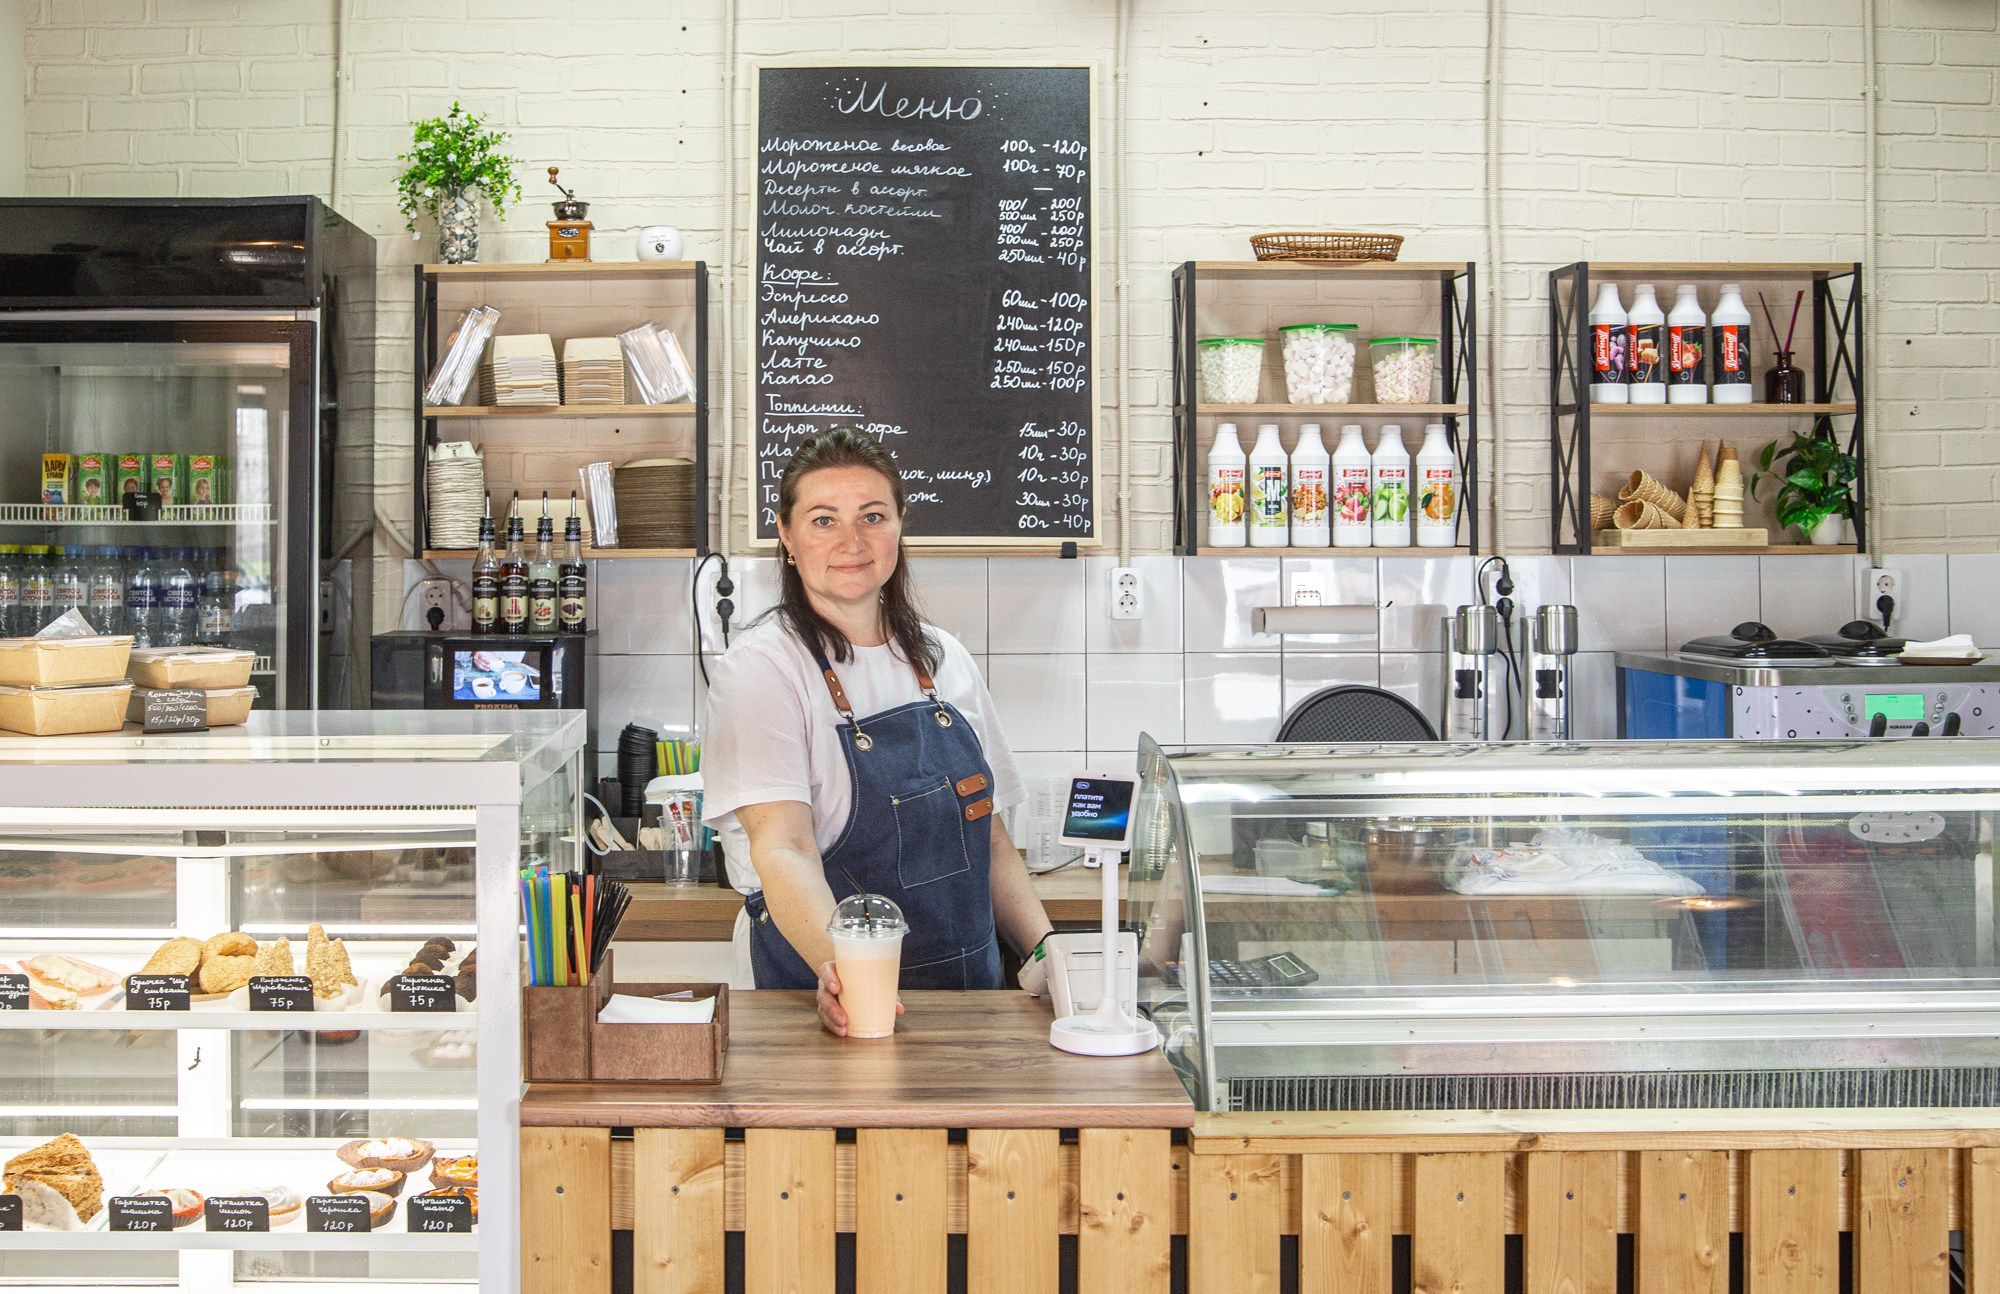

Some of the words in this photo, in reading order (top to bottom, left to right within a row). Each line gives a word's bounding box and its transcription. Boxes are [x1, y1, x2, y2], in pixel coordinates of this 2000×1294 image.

[838, 81, 982, 120] Меню
[761, 137, 882, 156] Мороженое
[891, 138, 951, 152] весовое
[762, 159, 883, 180] Мороженое
[891, 162, 973, 176] мягкое
[1002, 159, 1039, 173] 100г
[764, 179, 841, 202] Десерты
[851, 181, 860, 195] в
[870, 185, 928, 202] ассорт.
[763, 200, 840, 216] Молоч.
[844, 203, 942, 218] коктейли
[761, 222, 890, 246] Лимонады
[764, 238, 804, 254] Чай
[813, 239, 825, 255] в
[837, 242, 905, 261] ассорт.
[761, 284, 849, 311] Эспрессо
[761, 307, 880, 331] Американо
[762, 329, 861, 356] Капучино
[1597, 329, 1609, 366] Barinoff
[1671, 333, 1681, 369] Barinoff
[1725, 331, 1737, 369] Barinoff
[761, 350, 827, 369] Латте
[761, 371, 834, 385] Какао
[763, 418, 818, 443] Сироп
[130, 976, 166, 989] Булочка
[259, 977, 305, 986] Пирожное
[401, 977, 445, 987] Пирожное
[112, 1198, 169, 1208] Тарталетка
[209, 1198, 264, 1208] Тарталетка
[311, 1197, 367, 1207] Тарталетка
[318, 1205, 362, 1213] черника
[412, 1197, 465, 1207] Тарталетка
